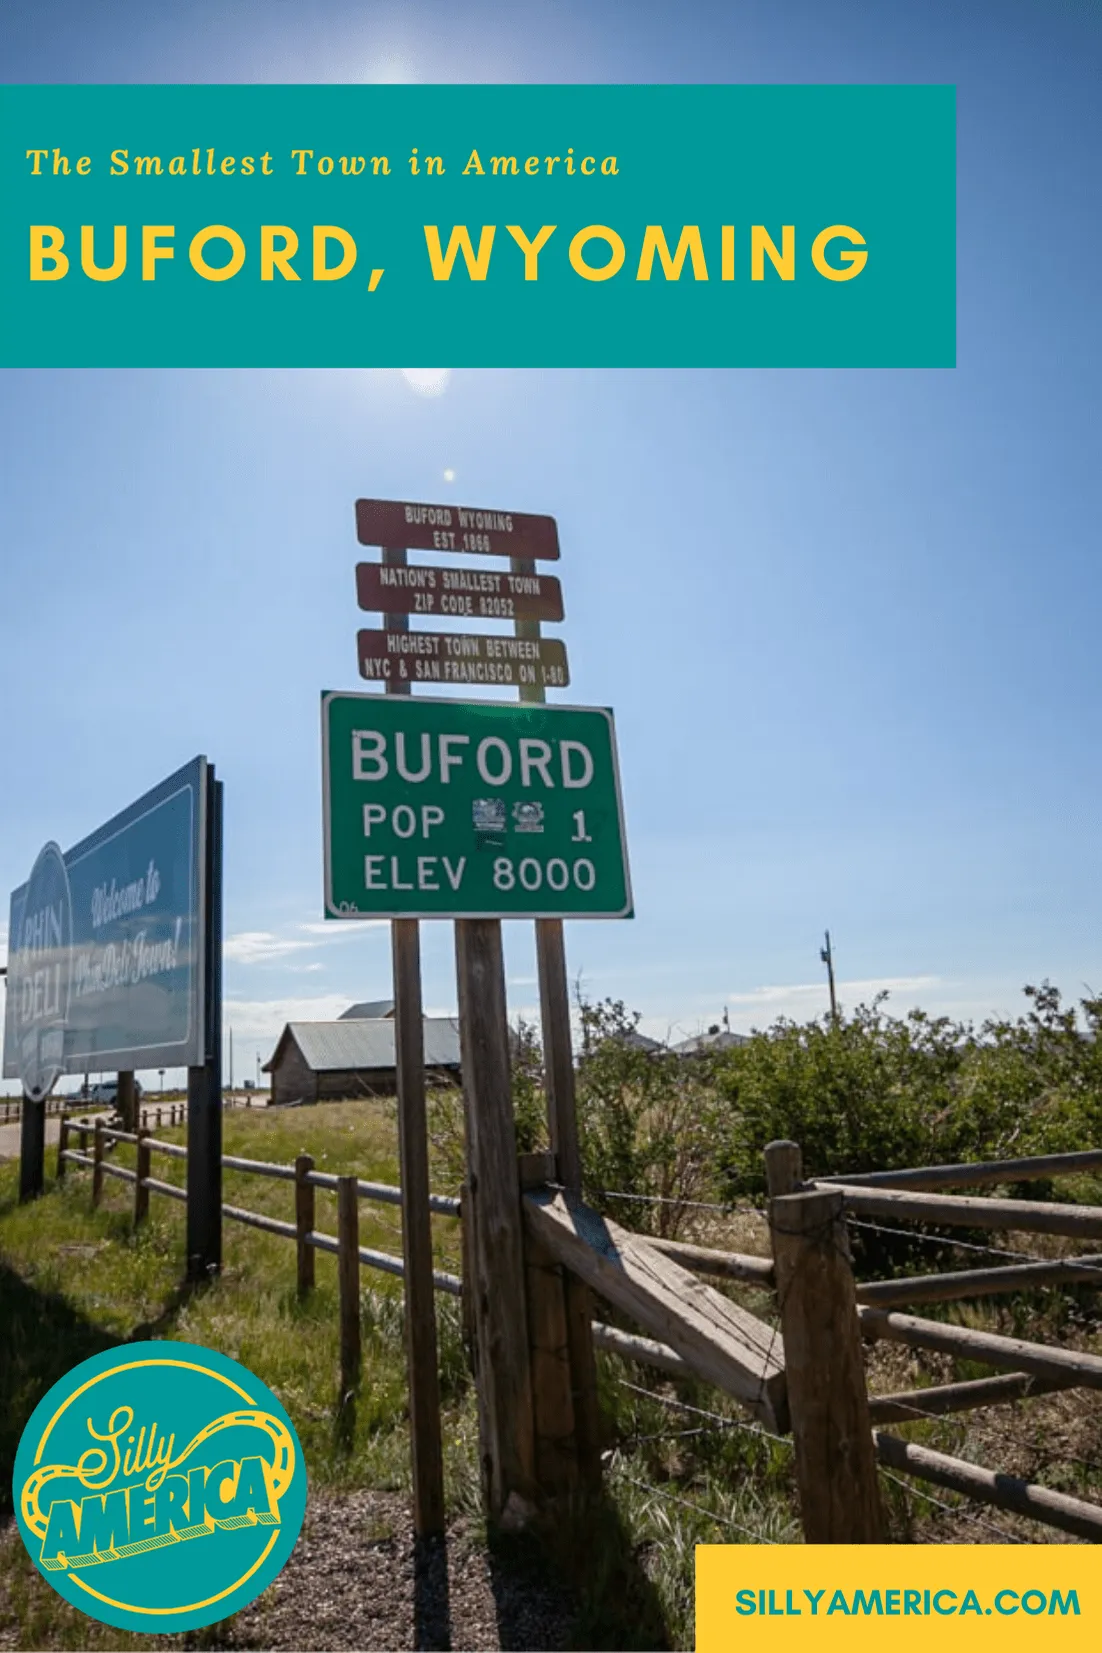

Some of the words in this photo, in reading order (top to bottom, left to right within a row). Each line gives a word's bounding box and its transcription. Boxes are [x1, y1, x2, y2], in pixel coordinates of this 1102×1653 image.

[404, 505, 452, 527] BUFORD
[459, 509, 513, 532] WYOMING
[433, 531, 455, 549] EST
[380, 567, 436, 588] NATION'S
[442, 571, 501, 592] SMALLEST
[508, 576, 541, 595] TOWN
[414, 593, 434, 612] ZIP
[441, 595, 473, 614] CODE
[387, 634, 440, 654] HIGHEST
[444, 637, 480, 656] TOWN
[486, 639, 541, 660] BETWEEN
[364, 658, 392, 678] NYC
[415, 660, 440, 679] SAN
[444, 662, 512, 682] FRANCISCO
[519, 664, 536, 684] ON
[352, 729, 594, 789] BUFORD
[362, 803, 446, 839] POP
[571, 809, 593, 842] 1
[364, 855, 467, 891] ELEV
[493, 857, 597, 892] 8000
[21, 963, 61, 1025] DELI
